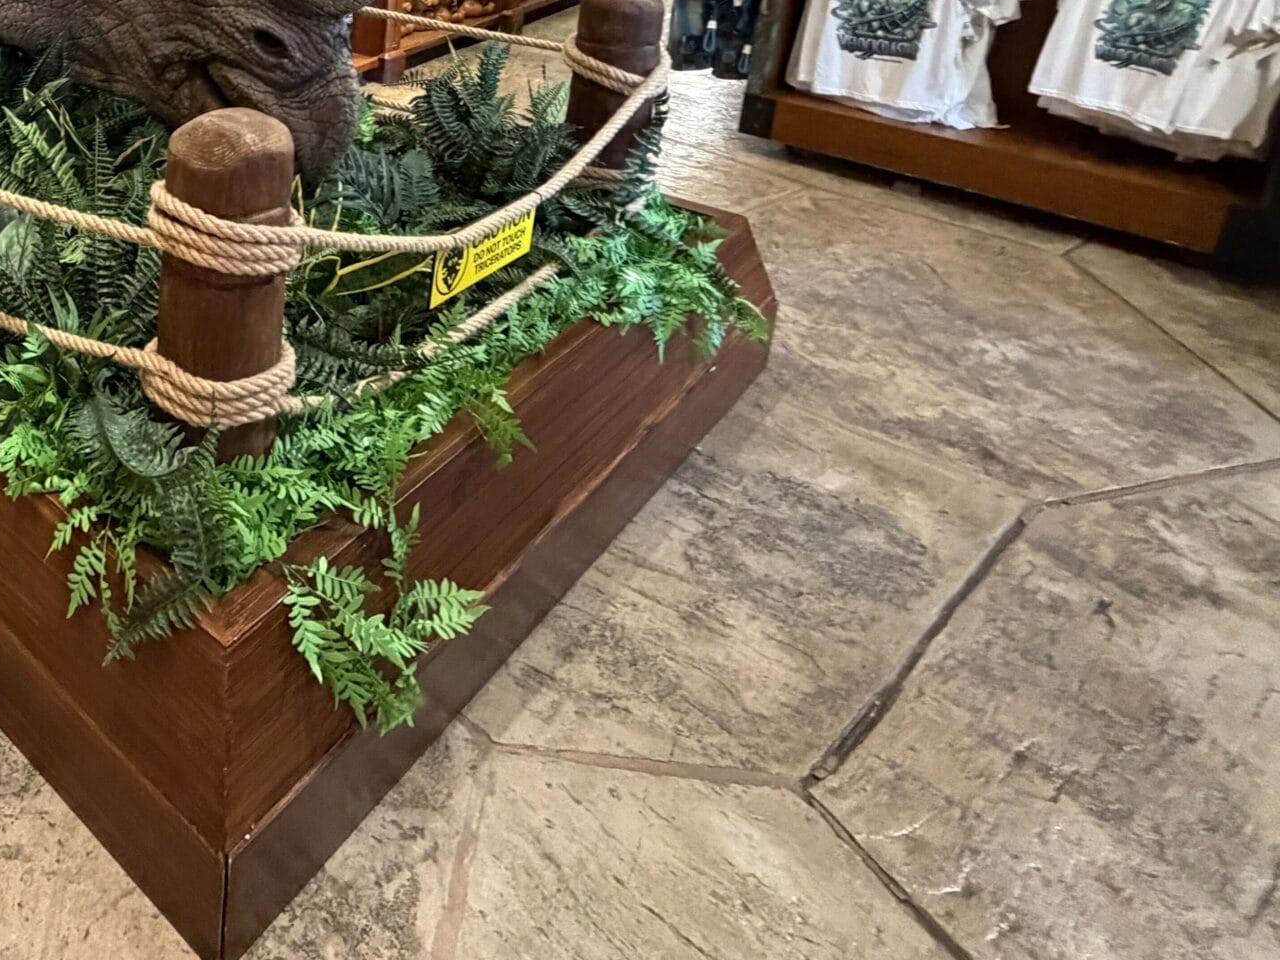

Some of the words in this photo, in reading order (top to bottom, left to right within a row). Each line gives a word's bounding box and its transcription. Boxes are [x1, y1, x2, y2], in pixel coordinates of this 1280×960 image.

[473, 249, 485, 263] DO
[486, 240, 501, 256] NOT
[502, 227, 526, 246] TOUCH
